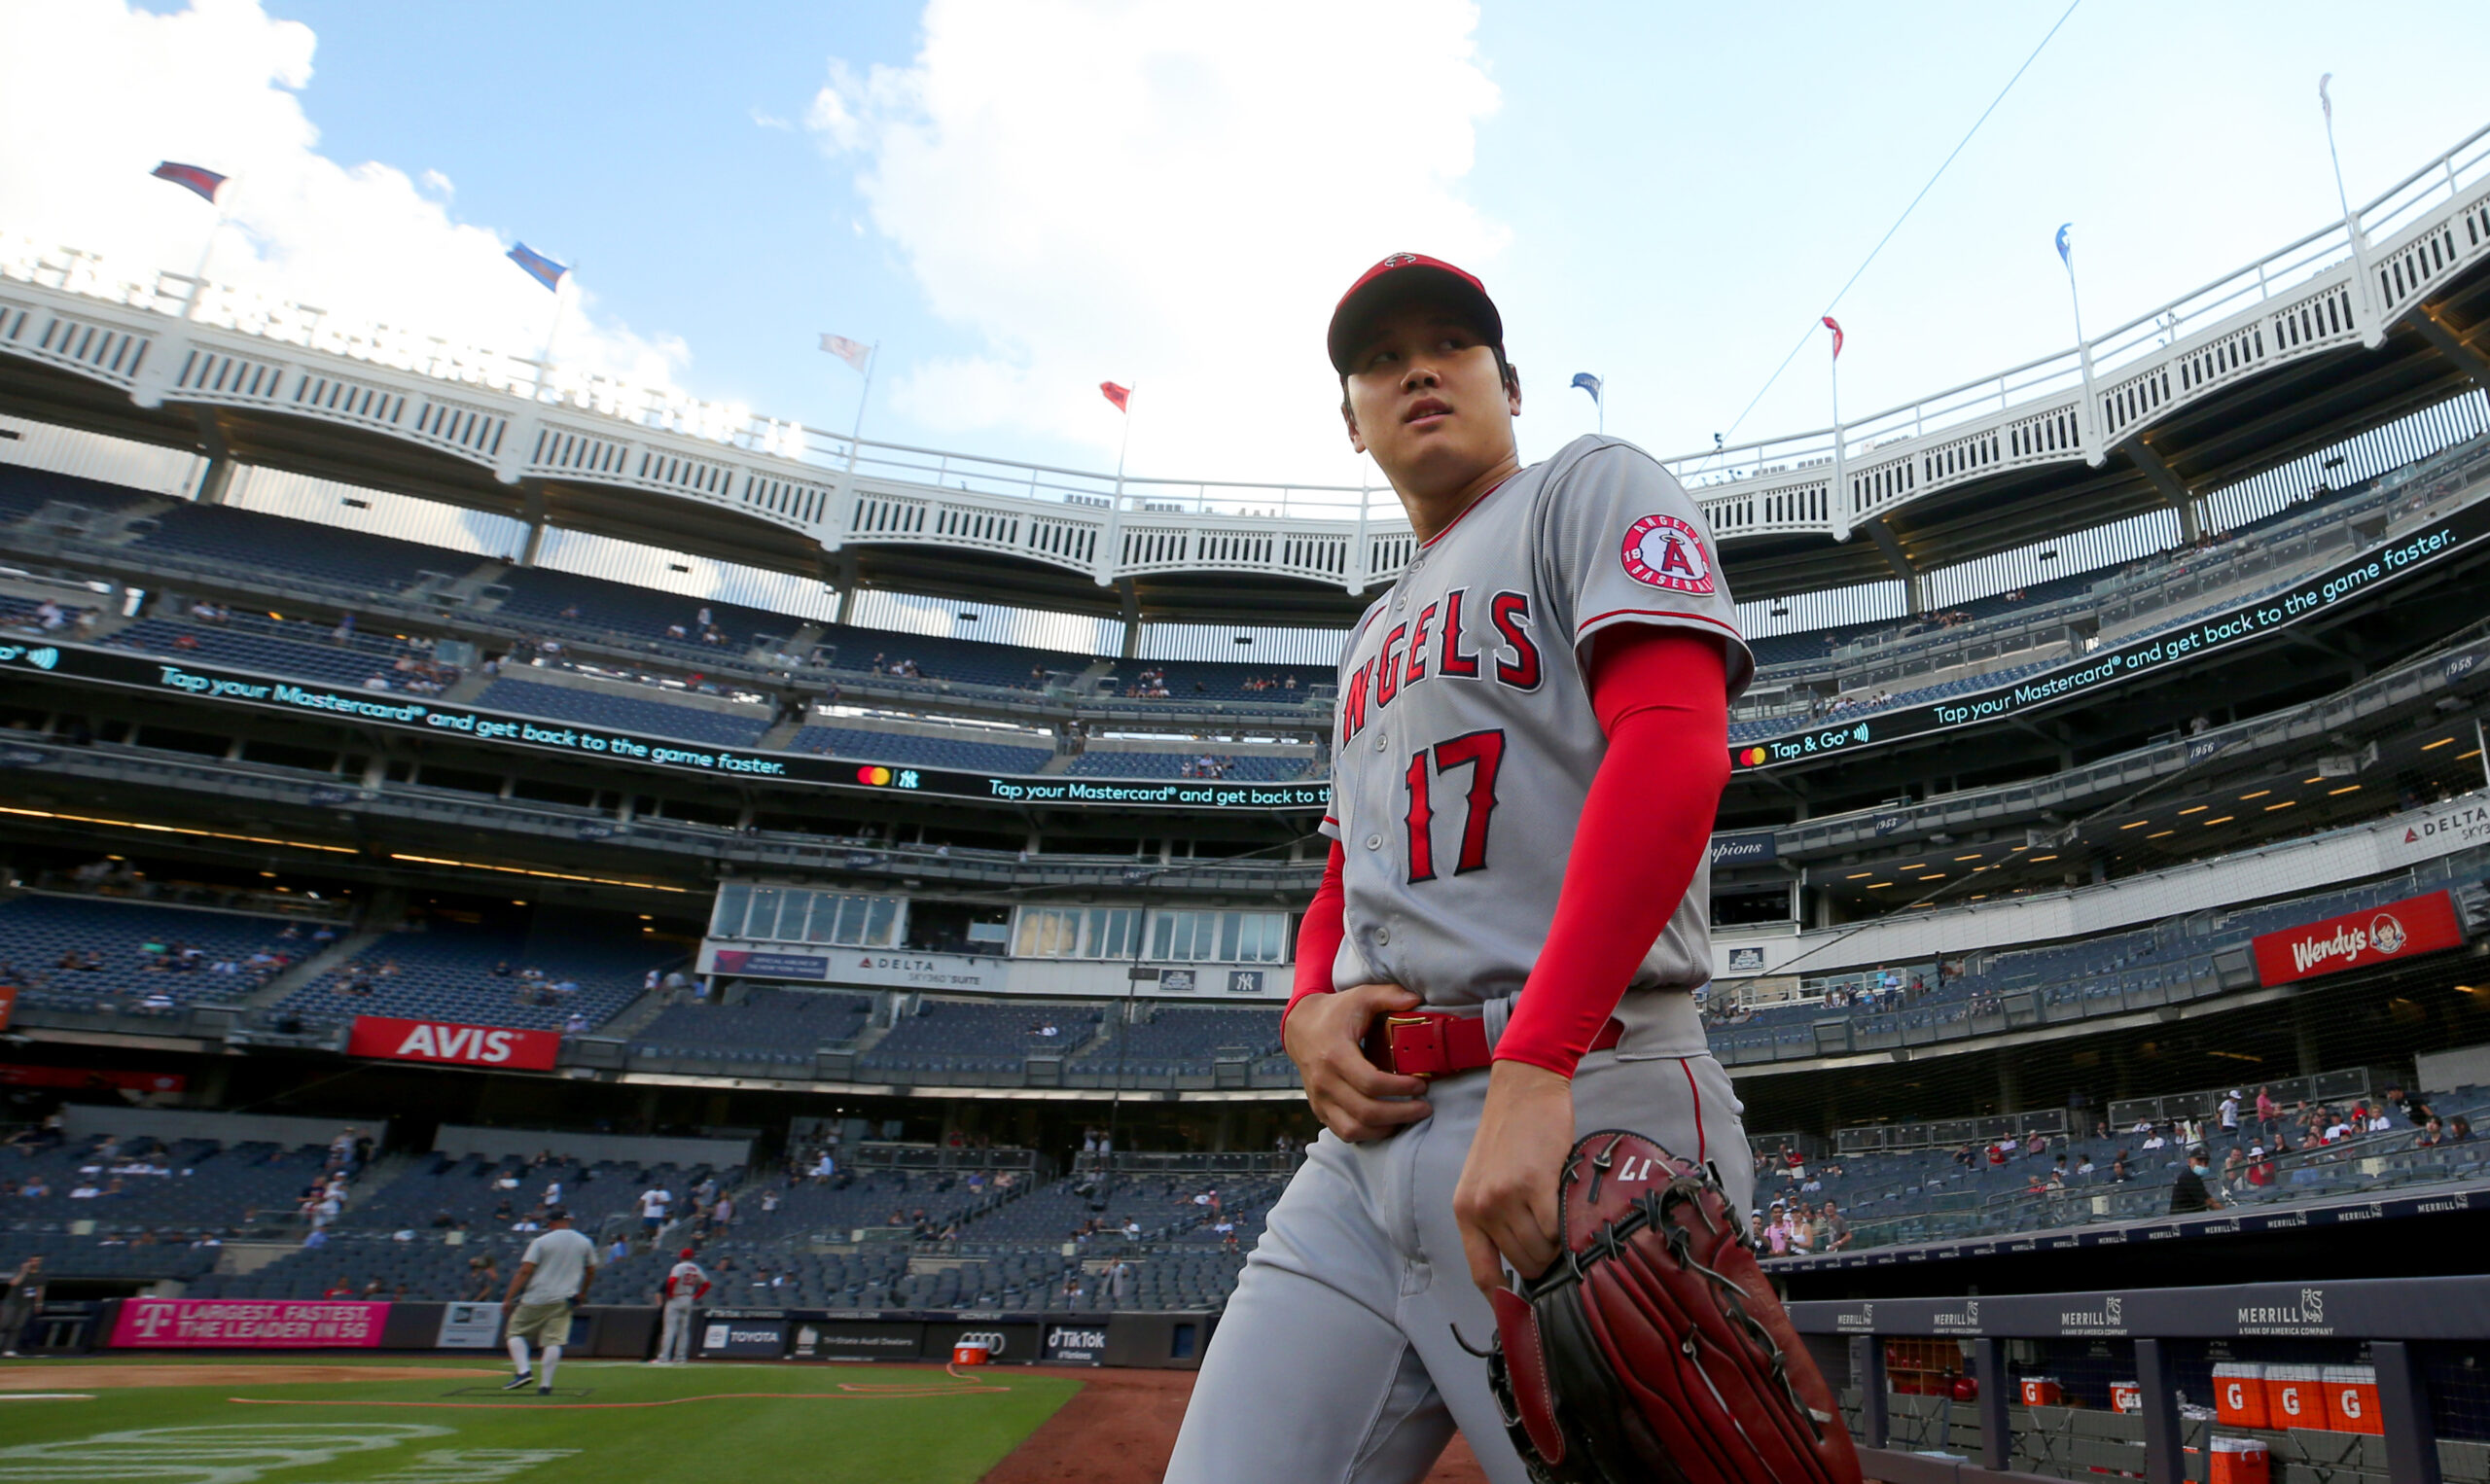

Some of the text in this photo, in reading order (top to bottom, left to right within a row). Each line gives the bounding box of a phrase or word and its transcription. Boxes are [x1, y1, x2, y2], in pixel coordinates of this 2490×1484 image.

[1633, 515, 1702, 545] ANGELS
[1623, 548, 1642, 563] 19
[1934, 706, 1969, 724] Tap
[1971, 695, 2011, 721] your
[2125, 641, 2161, 669] and
[2165, 631, 2200, 660] get
[2204, 614, 2255, 643] back
[2257, 607, 2282, 625] to
[2285, 590, 2318, 615] the
[2323, 562, 2380, 603] game
[2383, 528, 2457, 571] faster.
[1337, 586, 1545, 758] NGELS
[2446, 655, 2472, 677] 1958
[159, 664, 209, 692] Tap
[207, 680, 271, 697] your
[426, 713, 477, 731] and
[475, 720, 520, 739] get
[521, 724, 579, 748] back
[580, 732, 608, 752] to
[610, 737, 649, 758] the
[651, 745, 715, 767] game
[717, 753, 786, 775] faster.
[1770, 742, 1801, 760] Tap
[1804, 736, 1818, 752] &
[2190, 742, 2216, 759] 1956
[989, 779, 1022, 799] Tap
[1026, 785, 1066, 800] your
[1179, 788, 1213, 802] and
[1216, 790, 1247, 806] get
[1251, 789, 1292, 804] back
[1296, 789, 1314, 803] to
[1405, 727, 1507, 885] 17
[2423, 807, 2488, 836] DELTA
[2292, 924, 2367, 973] Wendy's
[878, 958, 935, 972] DELTA
[950, 974, 981, 985] SUITE
[2337, 1211, 2370, 1222] MERRILL
[2417, 1201, 2455, 1214] MERRILL
[2267, 1219, 2296, 1229] MERRILL
[178, 1304, 372, 1322] LARGEST. FASTEST.
[1837, 1314, 1862, 1325] MERRILL
[1934, 1314, 1966, 1325] MERRILL
[2062, 1312, 2105, 1325] MERRILL
[2238, 1306, 2299, 1324] MERRILL
[176, 1321, 370, 1338] THE LEADER IN 5G
[730, 1330, 779, 1343] TOYOTA
[2244, 1326, 2261, 1335] BANK
[2261, 1326, 2270, 1335] OF
[2270, 1326, 2299, 1336] AMERICA
[2300, 1326, 2334, 1336] COMPANY
[1062, 1330, 1106, 1349] TikTok
[2026, 1383, 2037, 1402] G
[2227, 1383, 2244, 1410] G
[2282, 1388, 2300, 1416] G
[2341, 1390, 2362, 1419] G
